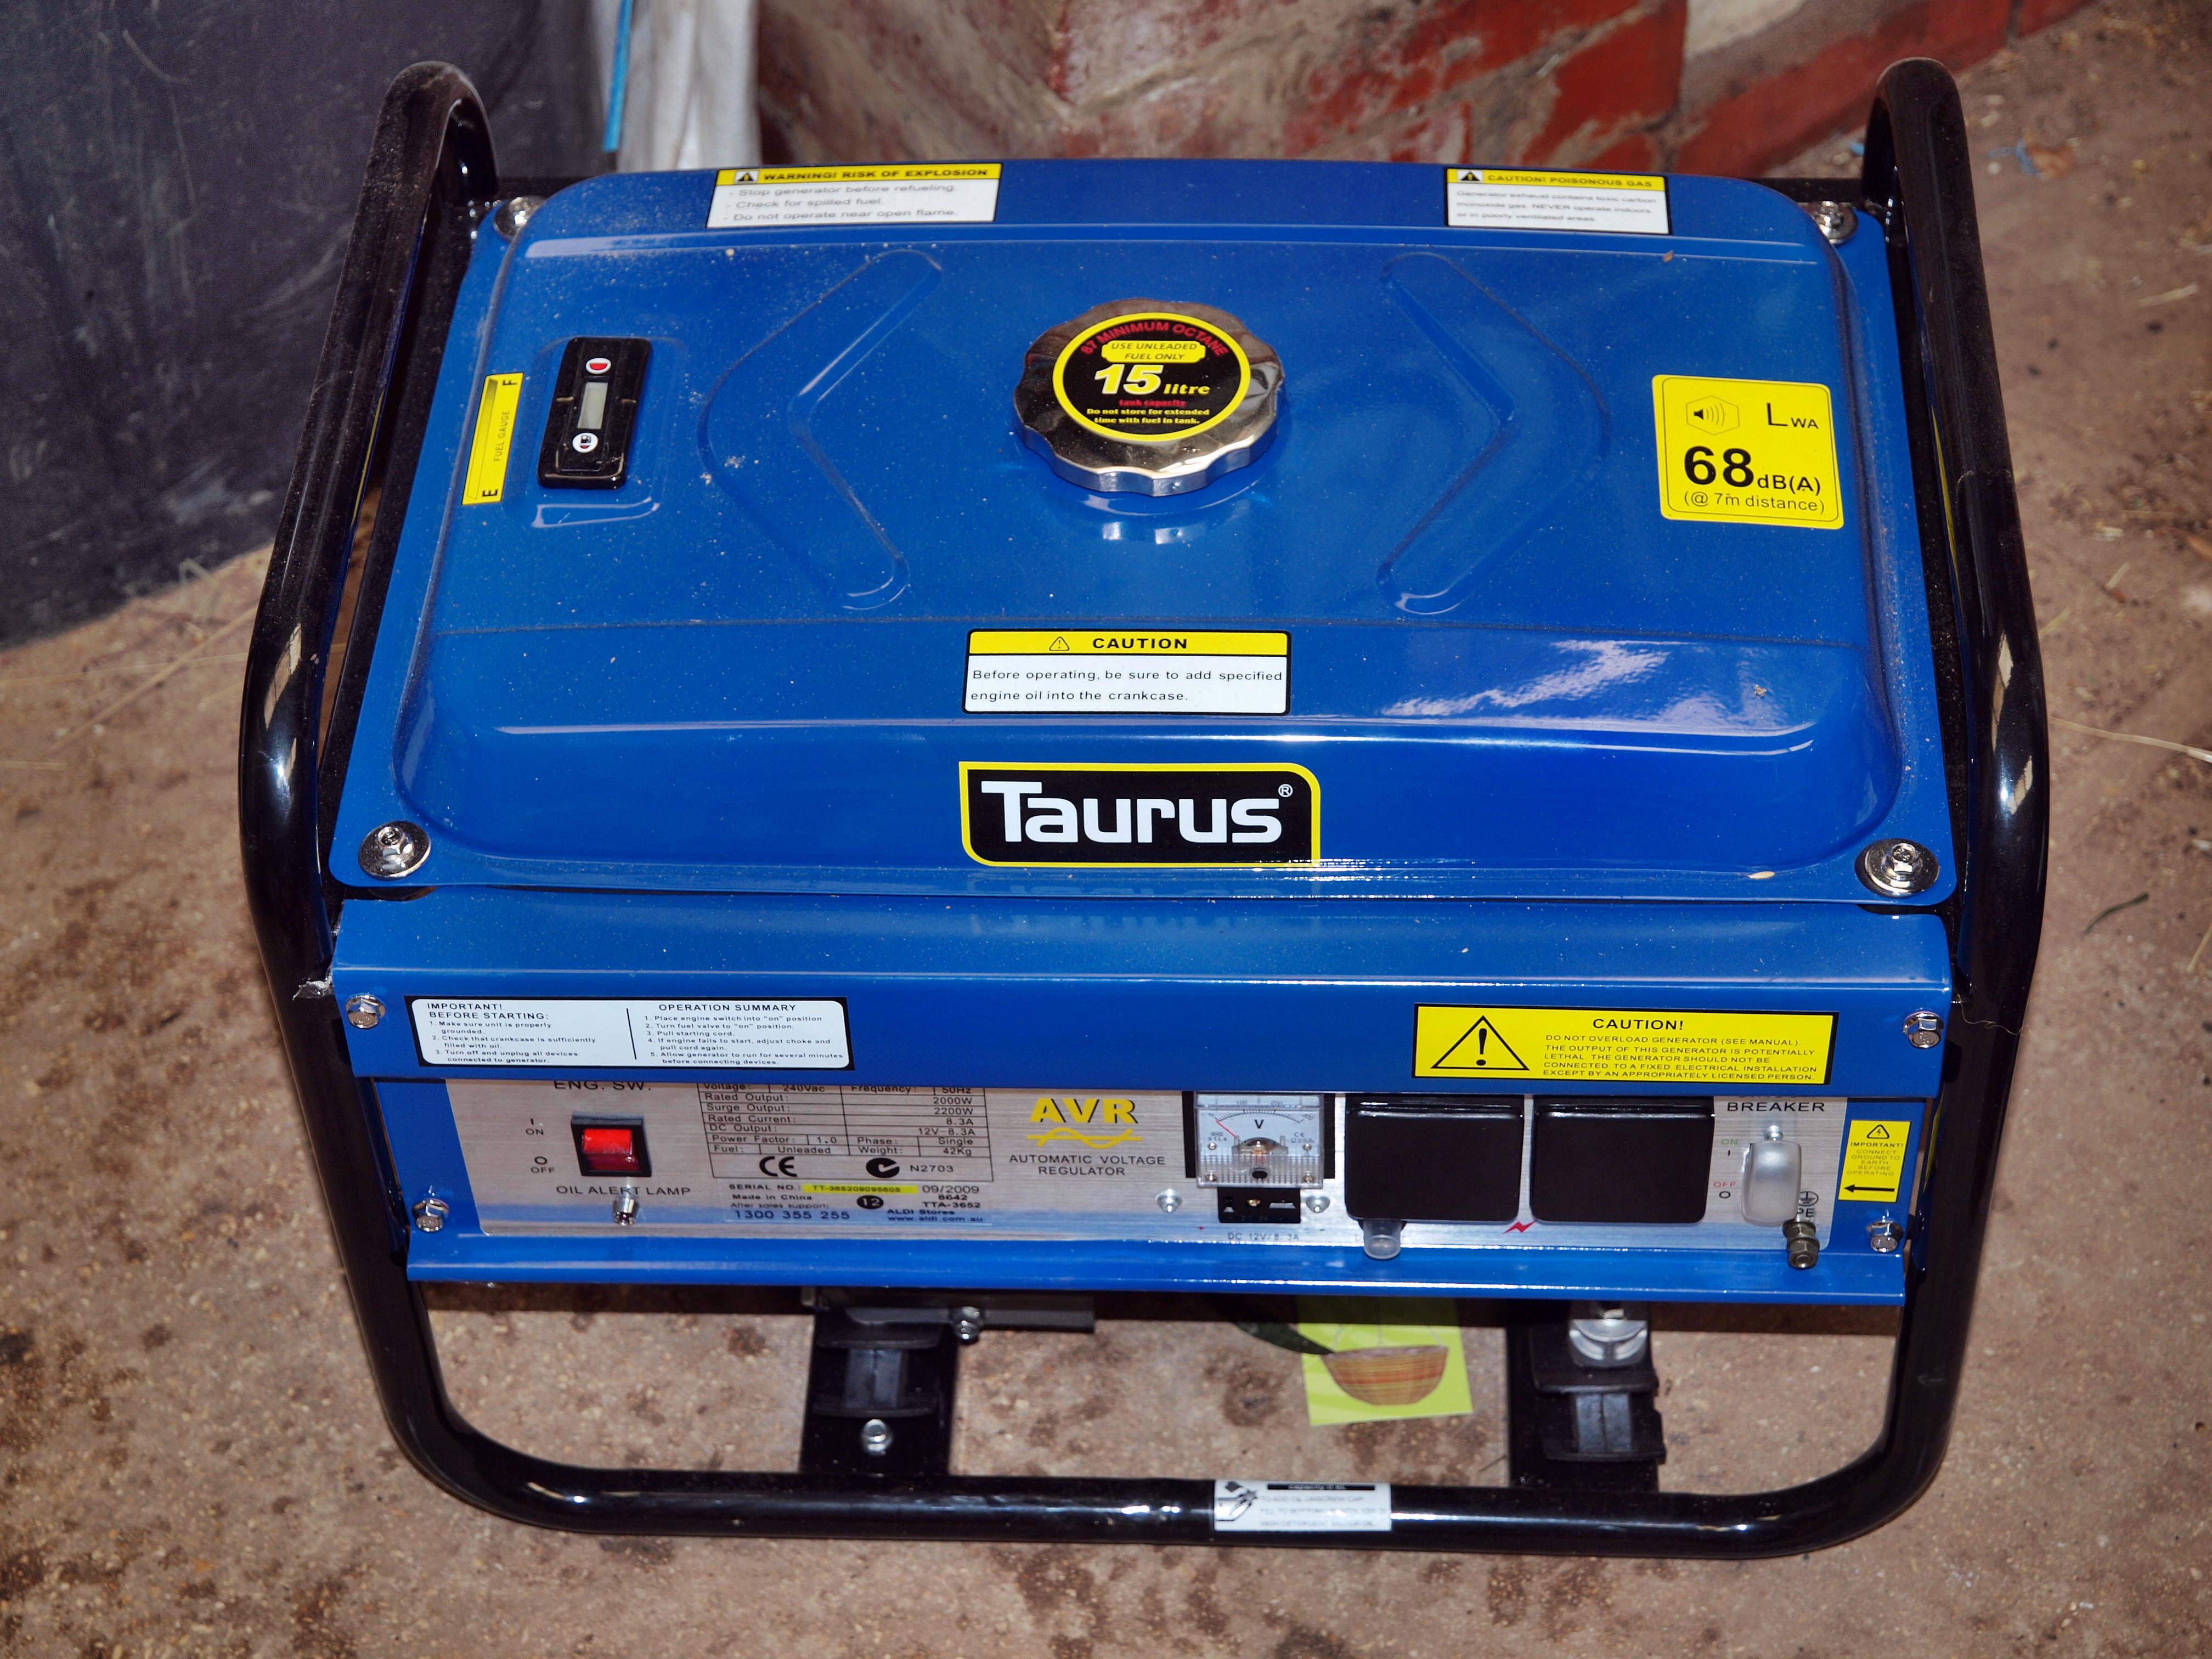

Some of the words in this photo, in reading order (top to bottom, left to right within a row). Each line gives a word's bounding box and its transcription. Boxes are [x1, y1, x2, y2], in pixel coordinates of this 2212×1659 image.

[1488, 174, 1546, 183] CAUTION!
[1550, 177, 1622, 185] POISONOUS
[1097, 322, 1169, 343] MINIMUM
[1172, 324, 1229, 356] OCTANE
[1094, 364, 1164, 395] 15
[1163, 383, 1210, 394] litre
[1144, 399, 1186, 408] capacity
[498, 410, 510, 437] GAUGE
[493, 441, 504, 462] FUEL
[482, 489, 498, 497] E
[1714, 493, 1740, 506] 7m
[1745, 494, 1824, 515] distance)
[1092, 637, 1188, 649] CAUTION
[973, 670, 1020, 680] Before
[1026, 670, 1100, 681] operating,
[1105, 670, 1121, 680] be
[1166, 671, 1178, 680] to
[1186, 671, 1211, 680] add
[1218, 671, 1283, 682] specified
[971, 691, 1020, 702] engine
[1025, 691, 1042, 700] oil
[1047, 691, 1075, 701] into
[1079, 691, 1102, 701] the
[1109, 691, 1188, 701] crankcase.
[1593, 1018, 1683, 1030] CAUTION!
[554, 1081, 607, 1091] ENG.
[612, 1081, 651, 1091] SW.
[704, 1092, 737, 1101] Rated
[746, 1093, 788, 1102] Output:
[707, 1103, 740, 1112] Surge
[1029, 1098, 1138, 1124] AVR
[1728, 1102, 1825, 1111] BREAKER
[708, 1114, 741, 1122] Rated
[1254, 1119, 1264, 1129] V
[938, 1137, 973, 1147] Single
[858, 1146, 902, 1155] Weight:
[943, 1148, 972, 1156] 42Kg
[1009, 1154, 1093, 1164] AUTOMATIC
[1101, 1155, 1165, 1165] VOLTAGE
[1039, 1166, 1125, 1176] REGULATOR
[556, 1186, 583, 1194] OIL
[646, 1187, 691, 1195] LAMP
[922, 1186, 979, 1194] 09/2009
[735, 1210, 774, 1218] 1300
[783, 1211, 811, 1219] 355
